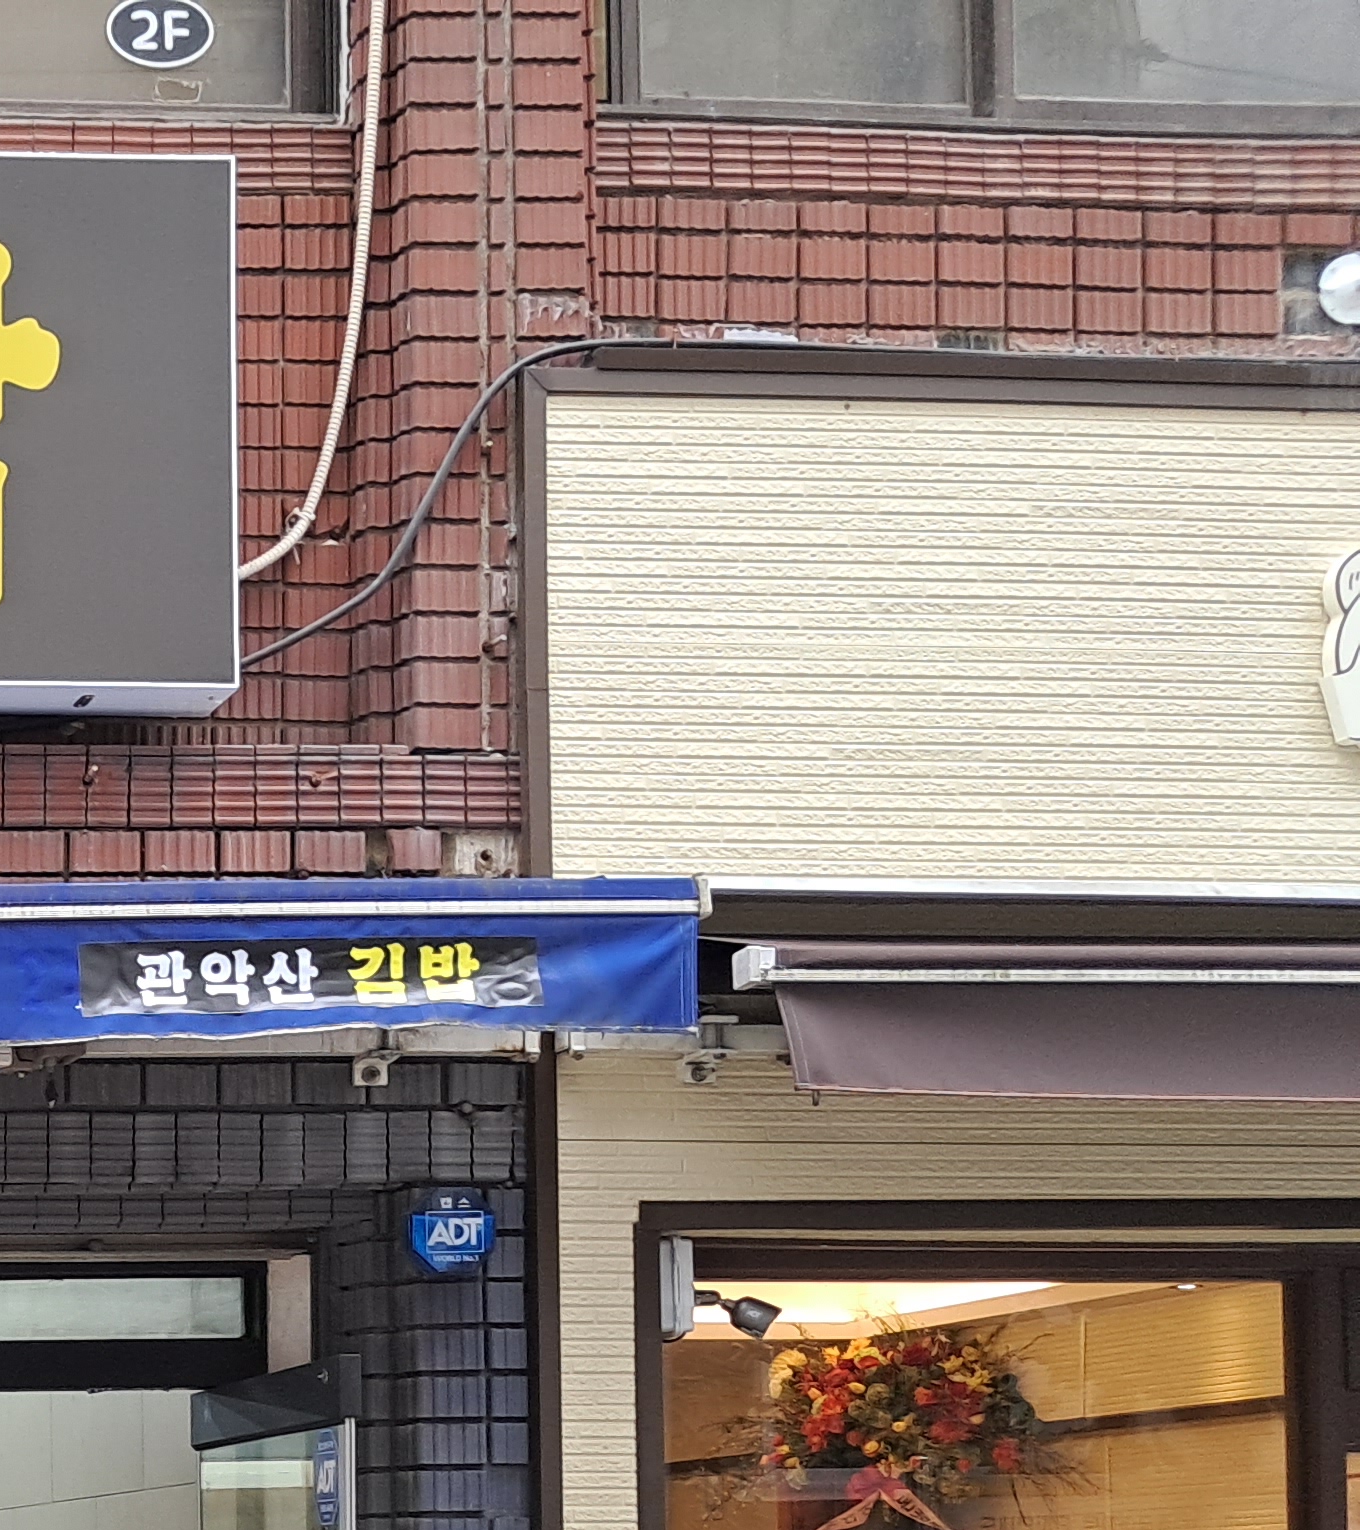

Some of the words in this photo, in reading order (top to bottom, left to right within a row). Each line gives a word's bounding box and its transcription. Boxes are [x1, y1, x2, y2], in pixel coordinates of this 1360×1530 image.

[130, 10, 190, 51] 2F
[135, 947, 320, 1007] 관악산
[347, 942, 480, 1004] 김밥
[427, 1218, 482, 1246] ADT
